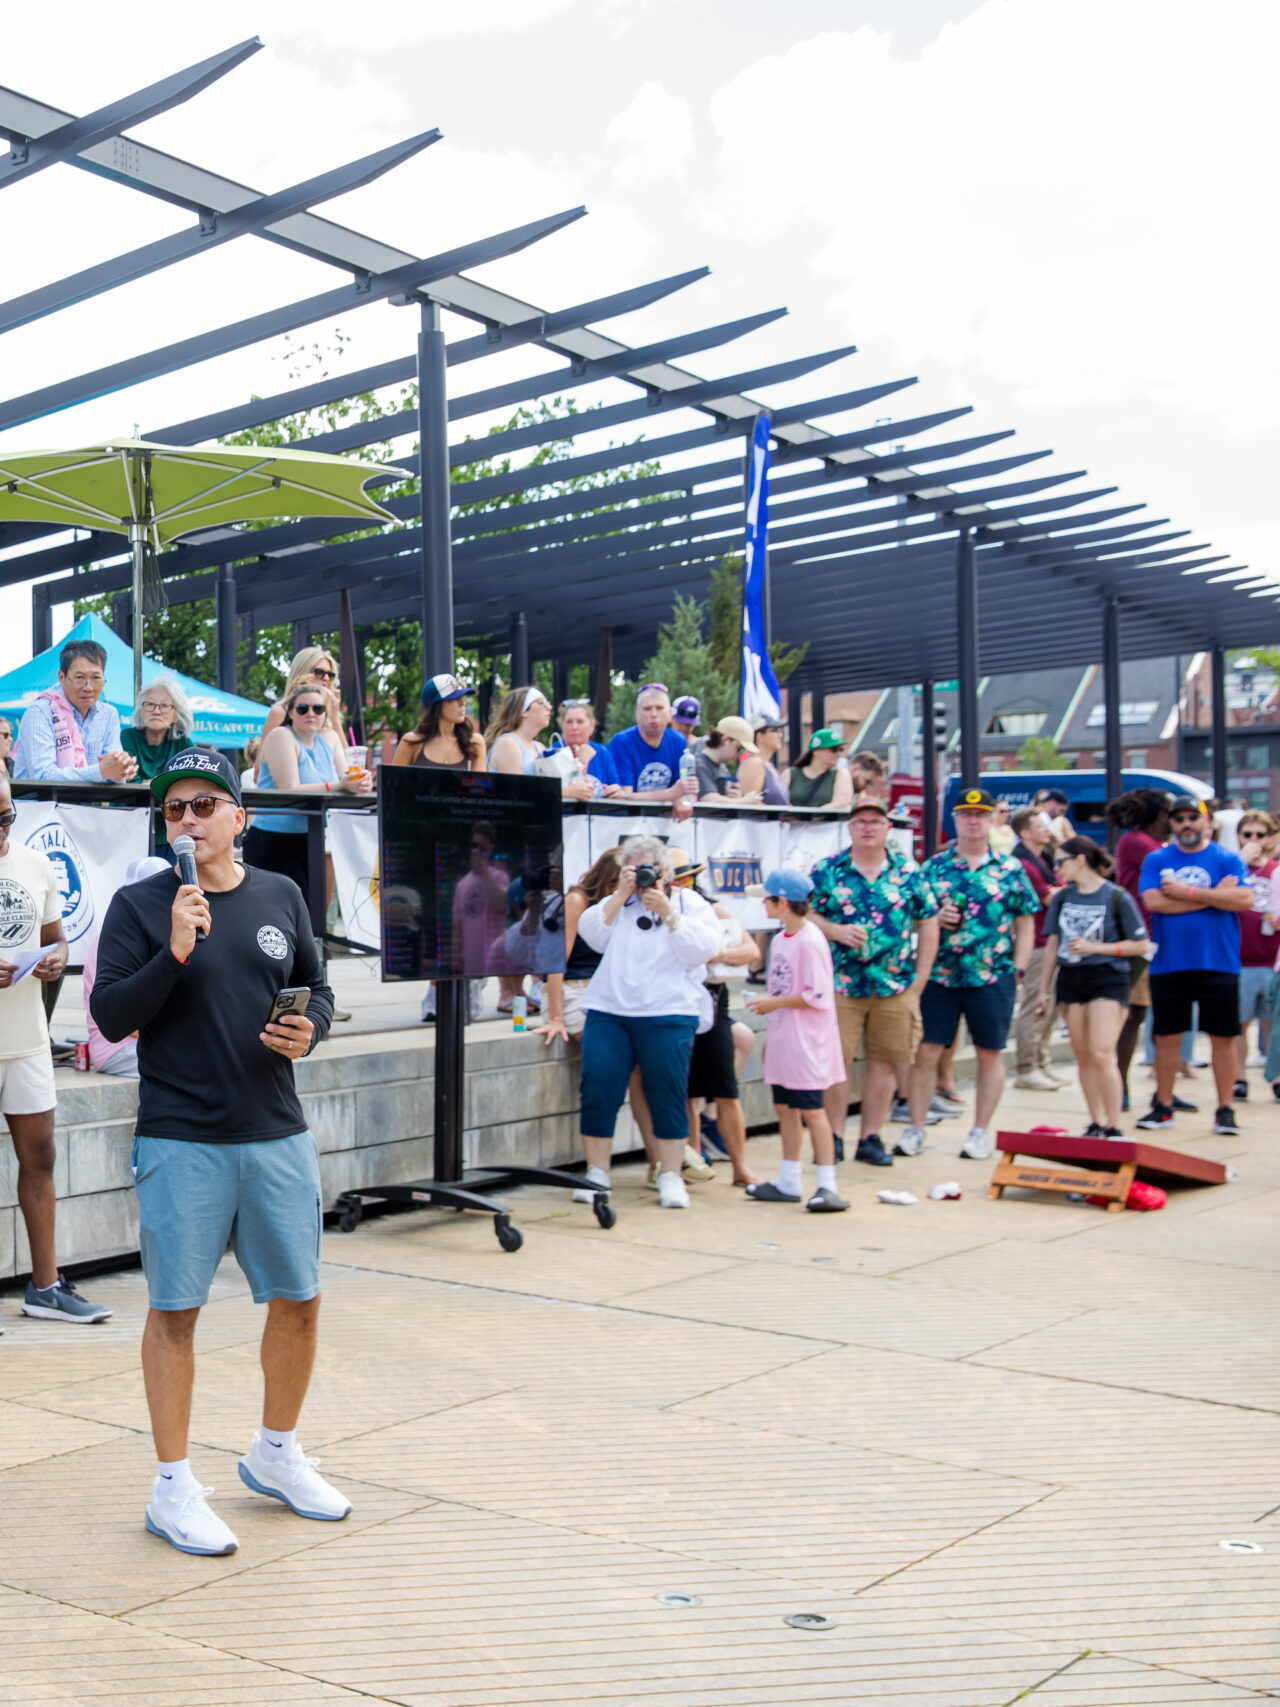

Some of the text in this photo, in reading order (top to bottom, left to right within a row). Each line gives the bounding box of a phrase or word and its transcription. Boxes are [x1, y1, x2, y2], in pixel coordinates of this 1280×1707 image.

[195, 757, 221, 772] End
[40, 829, 67, 850] TALL
[5, 881, 20, 890] END
